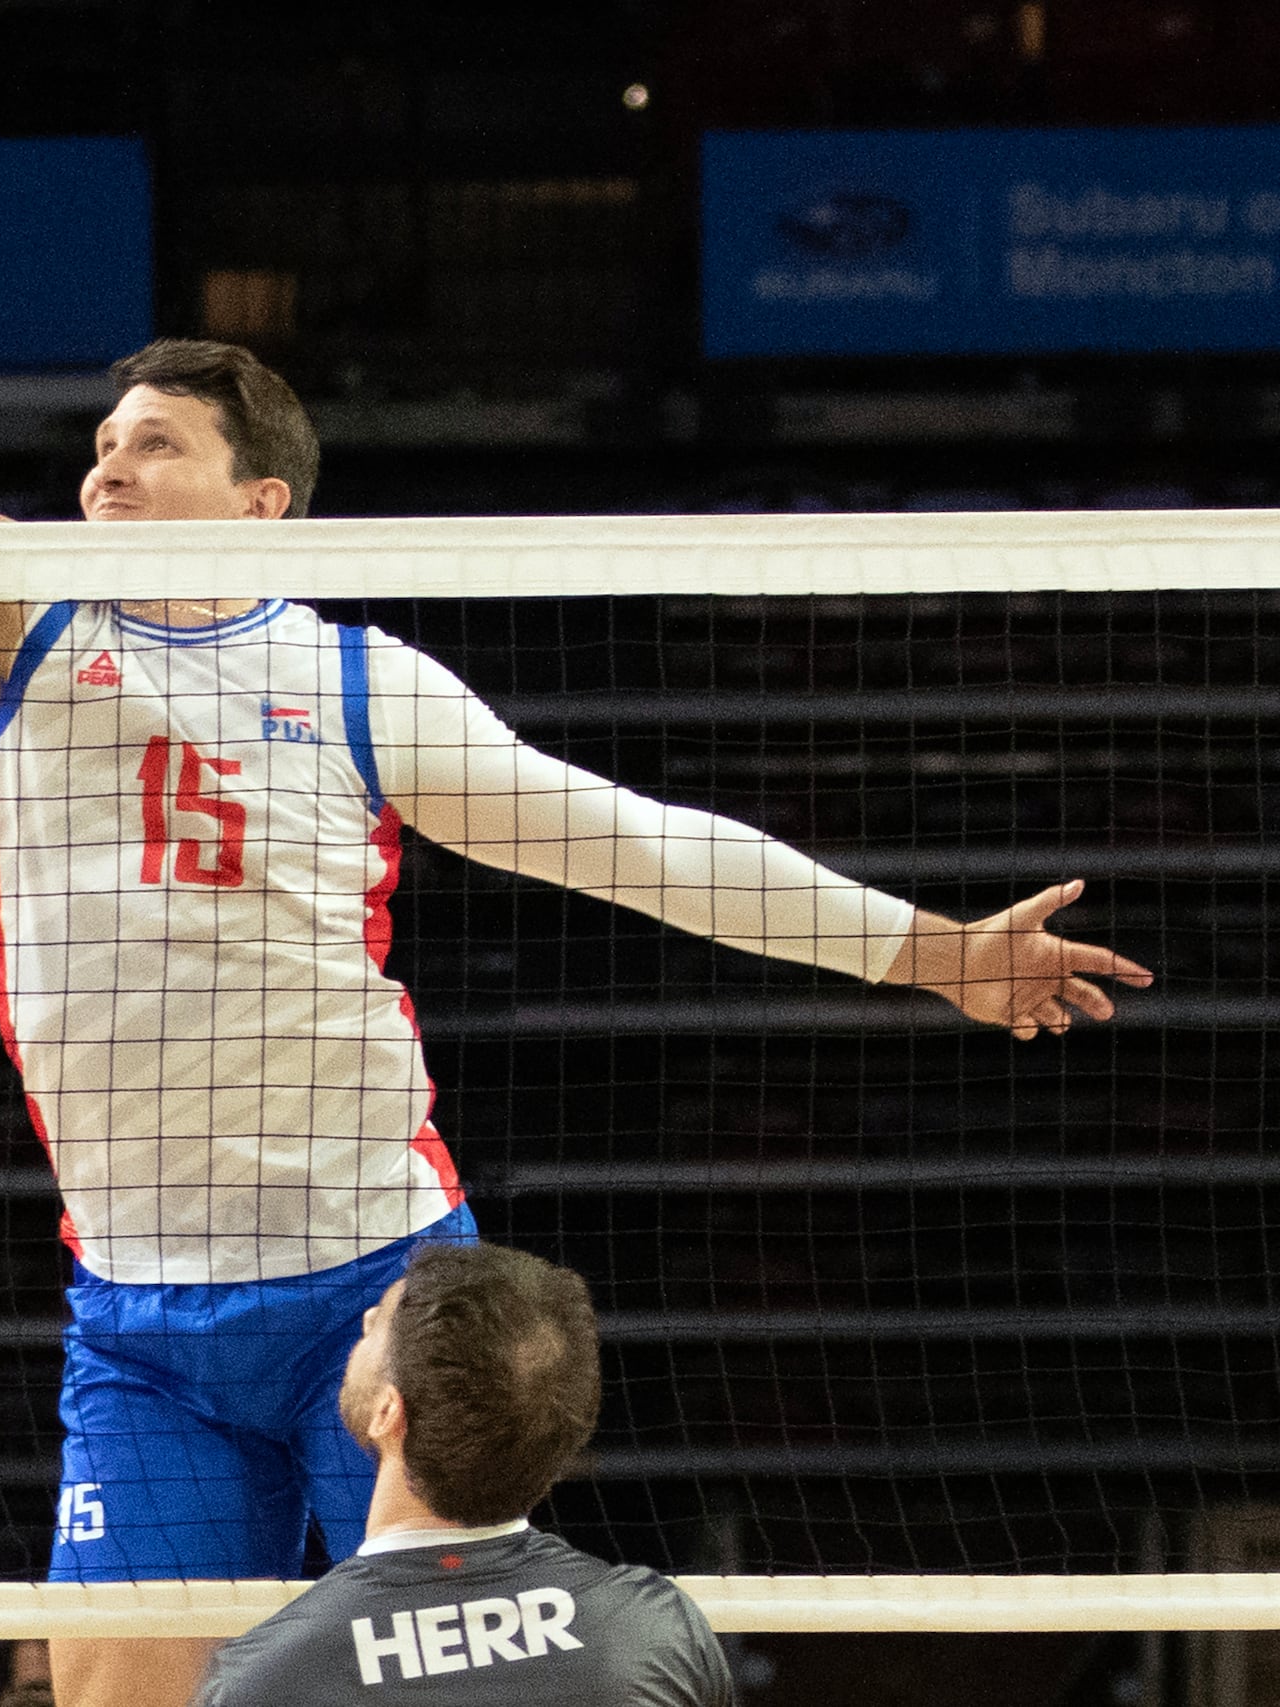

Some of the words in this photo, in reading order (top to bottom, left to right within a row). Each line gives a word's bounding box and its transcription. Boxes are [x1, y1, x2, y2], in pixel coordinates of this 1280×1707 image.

[137, 735, 247, 888] 15
[58, 1482, 105, 1546] 15
[351, 1586, 584, 1686] HERR
